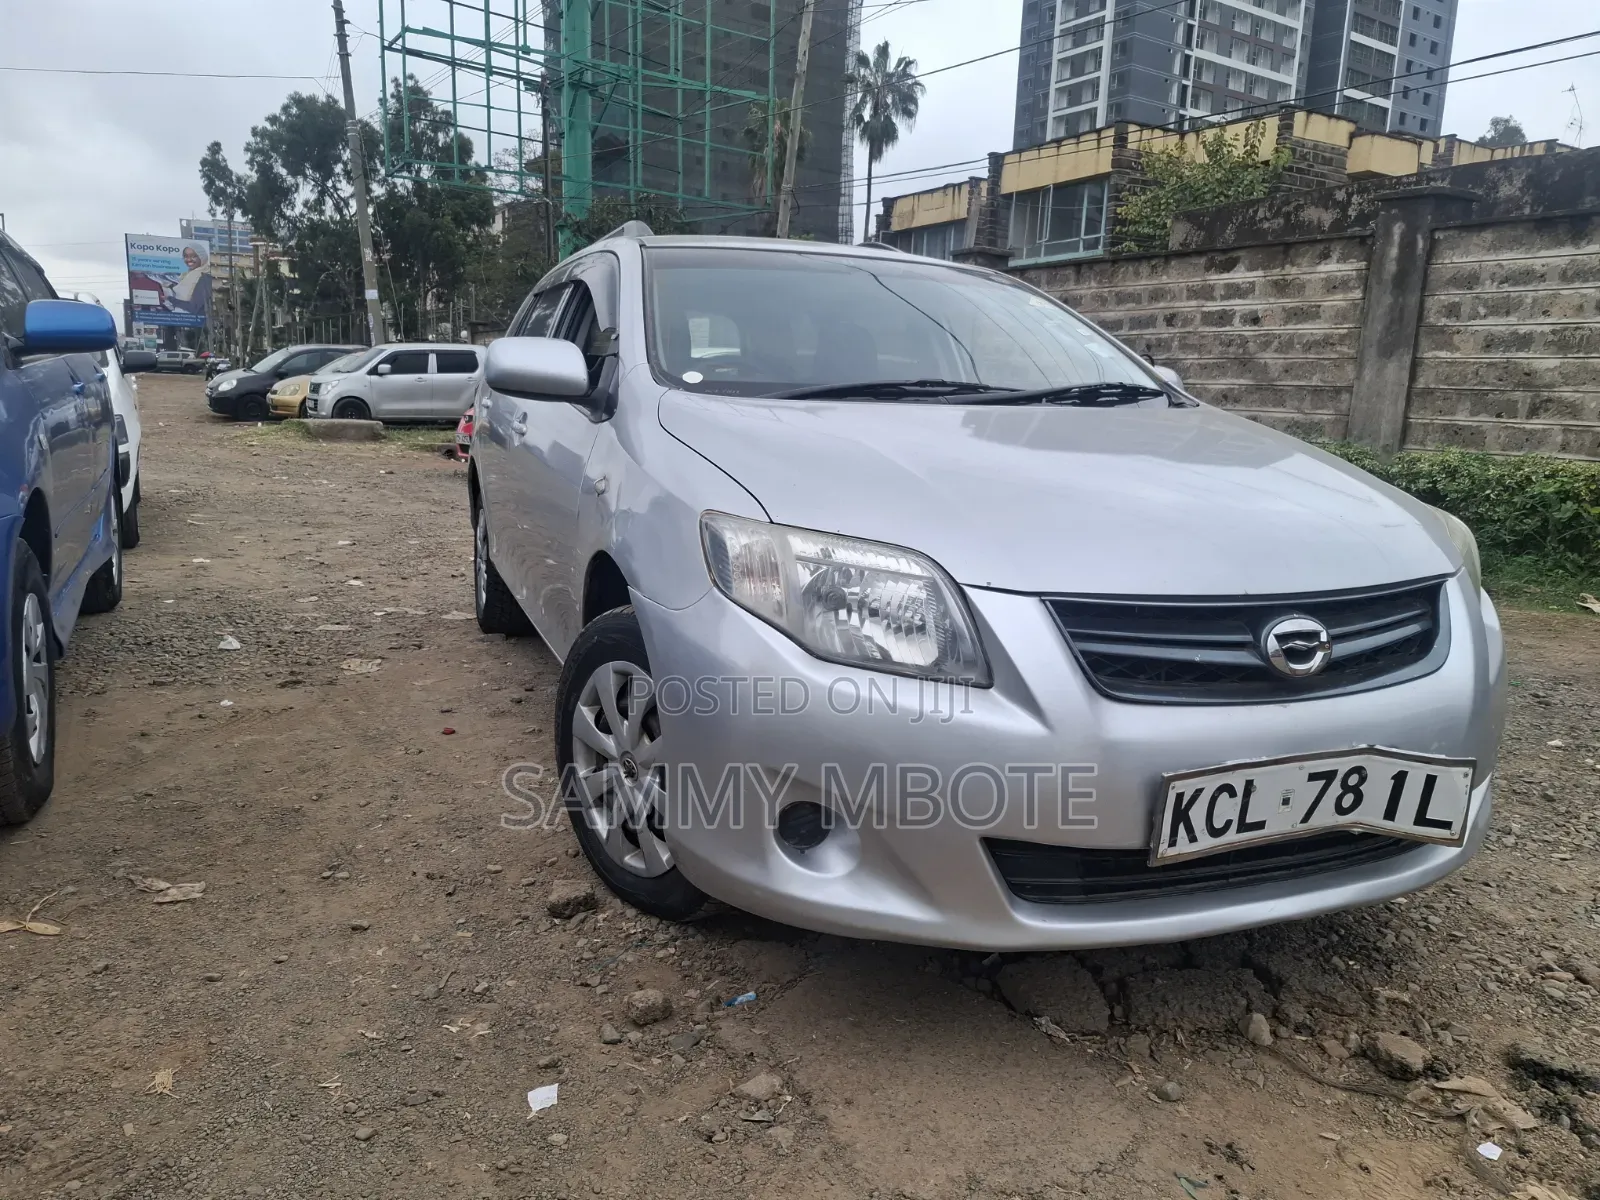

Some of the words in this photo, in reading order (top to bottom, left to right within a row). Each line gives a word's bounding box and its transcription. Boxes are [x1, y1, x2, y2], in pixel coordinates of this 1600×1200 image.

[130, 242, 154, 253] Kopo
[156, 245, 180, 255] Kopo
[1167, 779, 1267, 848] KCL
